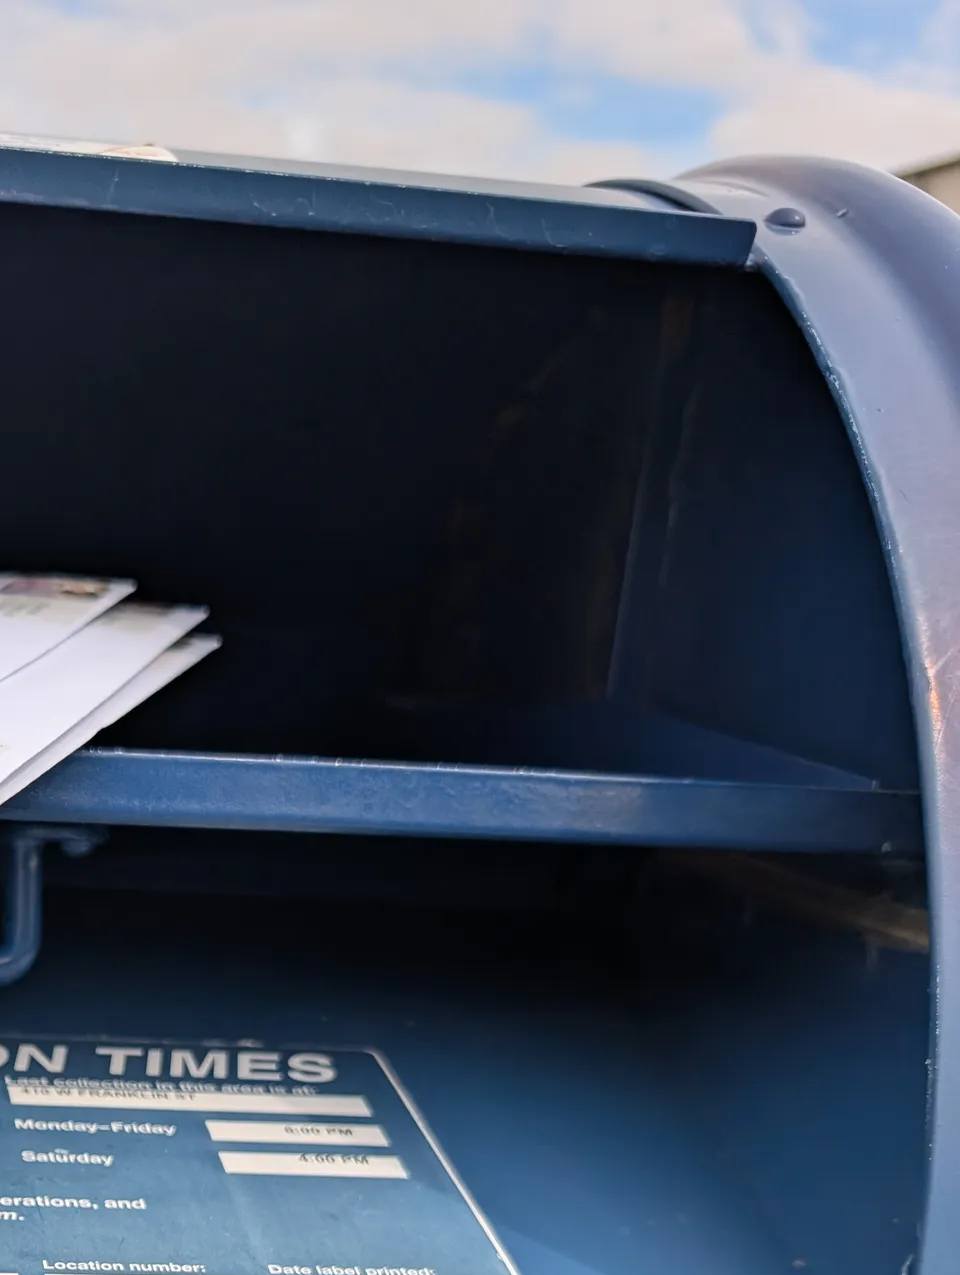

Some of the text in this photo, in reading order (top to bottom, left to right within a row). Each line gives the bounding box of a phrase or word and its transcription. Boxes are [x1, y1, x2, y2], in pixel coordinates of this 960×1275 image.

[96, 1047, 338, 1083] TIMES
[5, 1075, 48, 1088] Last
[53, 1077, 152, 1091] collection
[156, 1079, 174, 1091] in
[180, 1080, 215, 1093] this
[221, 1083, 264, 1094] area
[269, 1083, 285, 1095] is
[55, 1087, 72, 1097] W
[78, 1089, 169, 1100] FRANKLIN
[326, 1126, 354, 1137] PM
[21, 1149, 114, 1168] Saturday
[340, 1154, 370, 1166] PM
[104, 1198, 147, 1210] and
[42, 1259, 206, 1273] Location number:
[268, 1264, 312, 1275] Date
